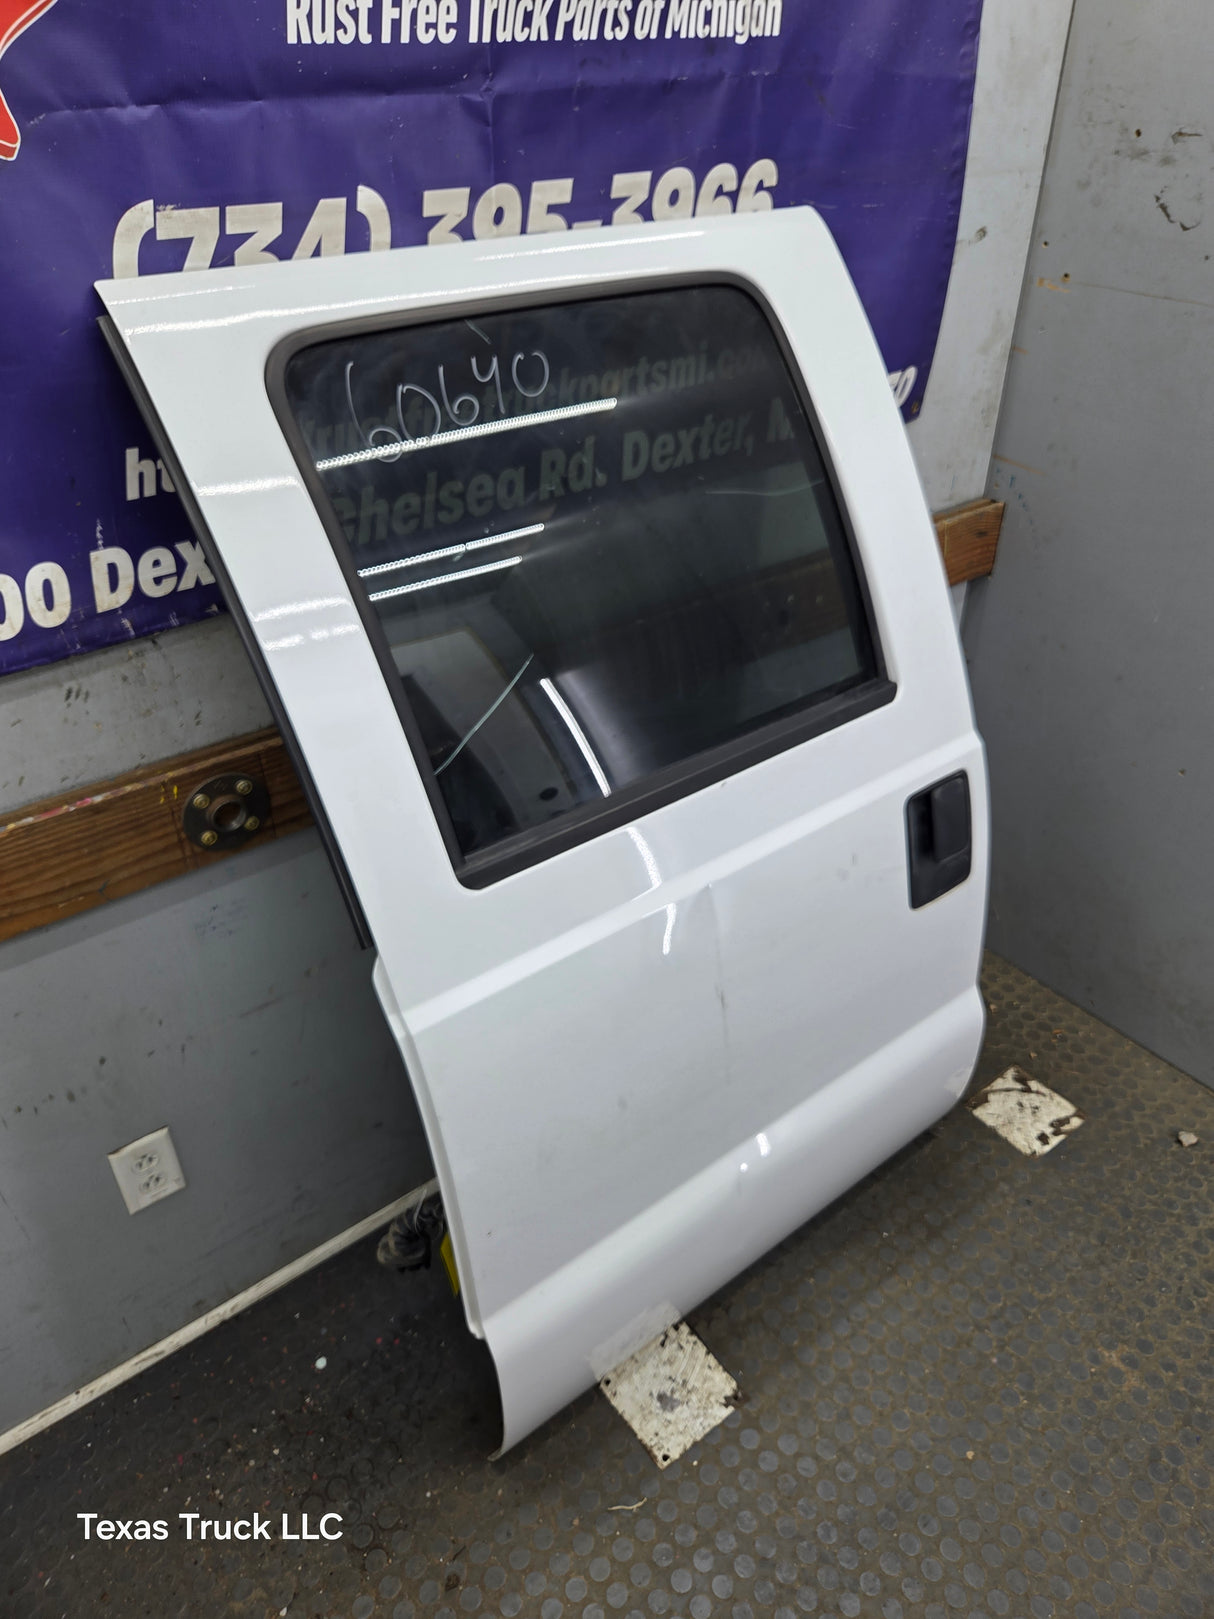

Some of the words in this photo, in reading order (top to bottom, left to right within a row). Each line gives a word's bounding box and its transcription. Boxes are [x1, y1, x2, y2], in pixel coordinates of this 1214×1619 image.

[286, 0, 373, 45] Rust
[380, 0, 459, 45] Free
[468, 0, 550, 44] Truck
[554, 0, 633, 42] Parts
[634, 0, 665, 41] of
[664, 0, 783, 45] Michigan
